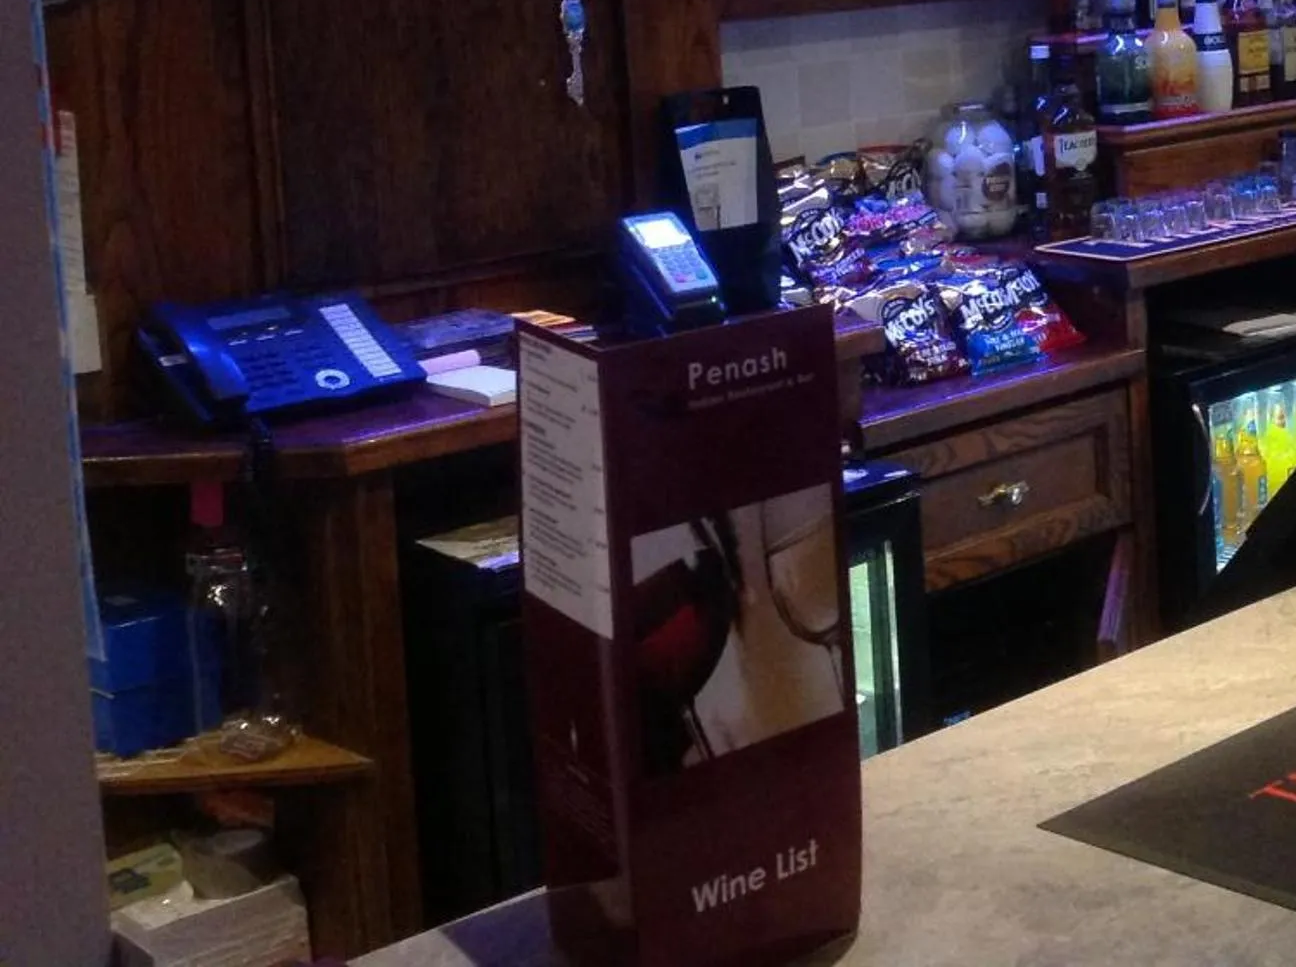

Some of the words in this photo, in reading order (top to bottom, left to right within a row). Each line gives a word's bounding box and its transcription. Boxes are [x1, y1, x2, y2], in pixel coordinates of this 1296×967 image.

[688, 346, 788, 391] Penash
[690, 866, 767, 913] Wine
[777, 838, 820, 882] List
